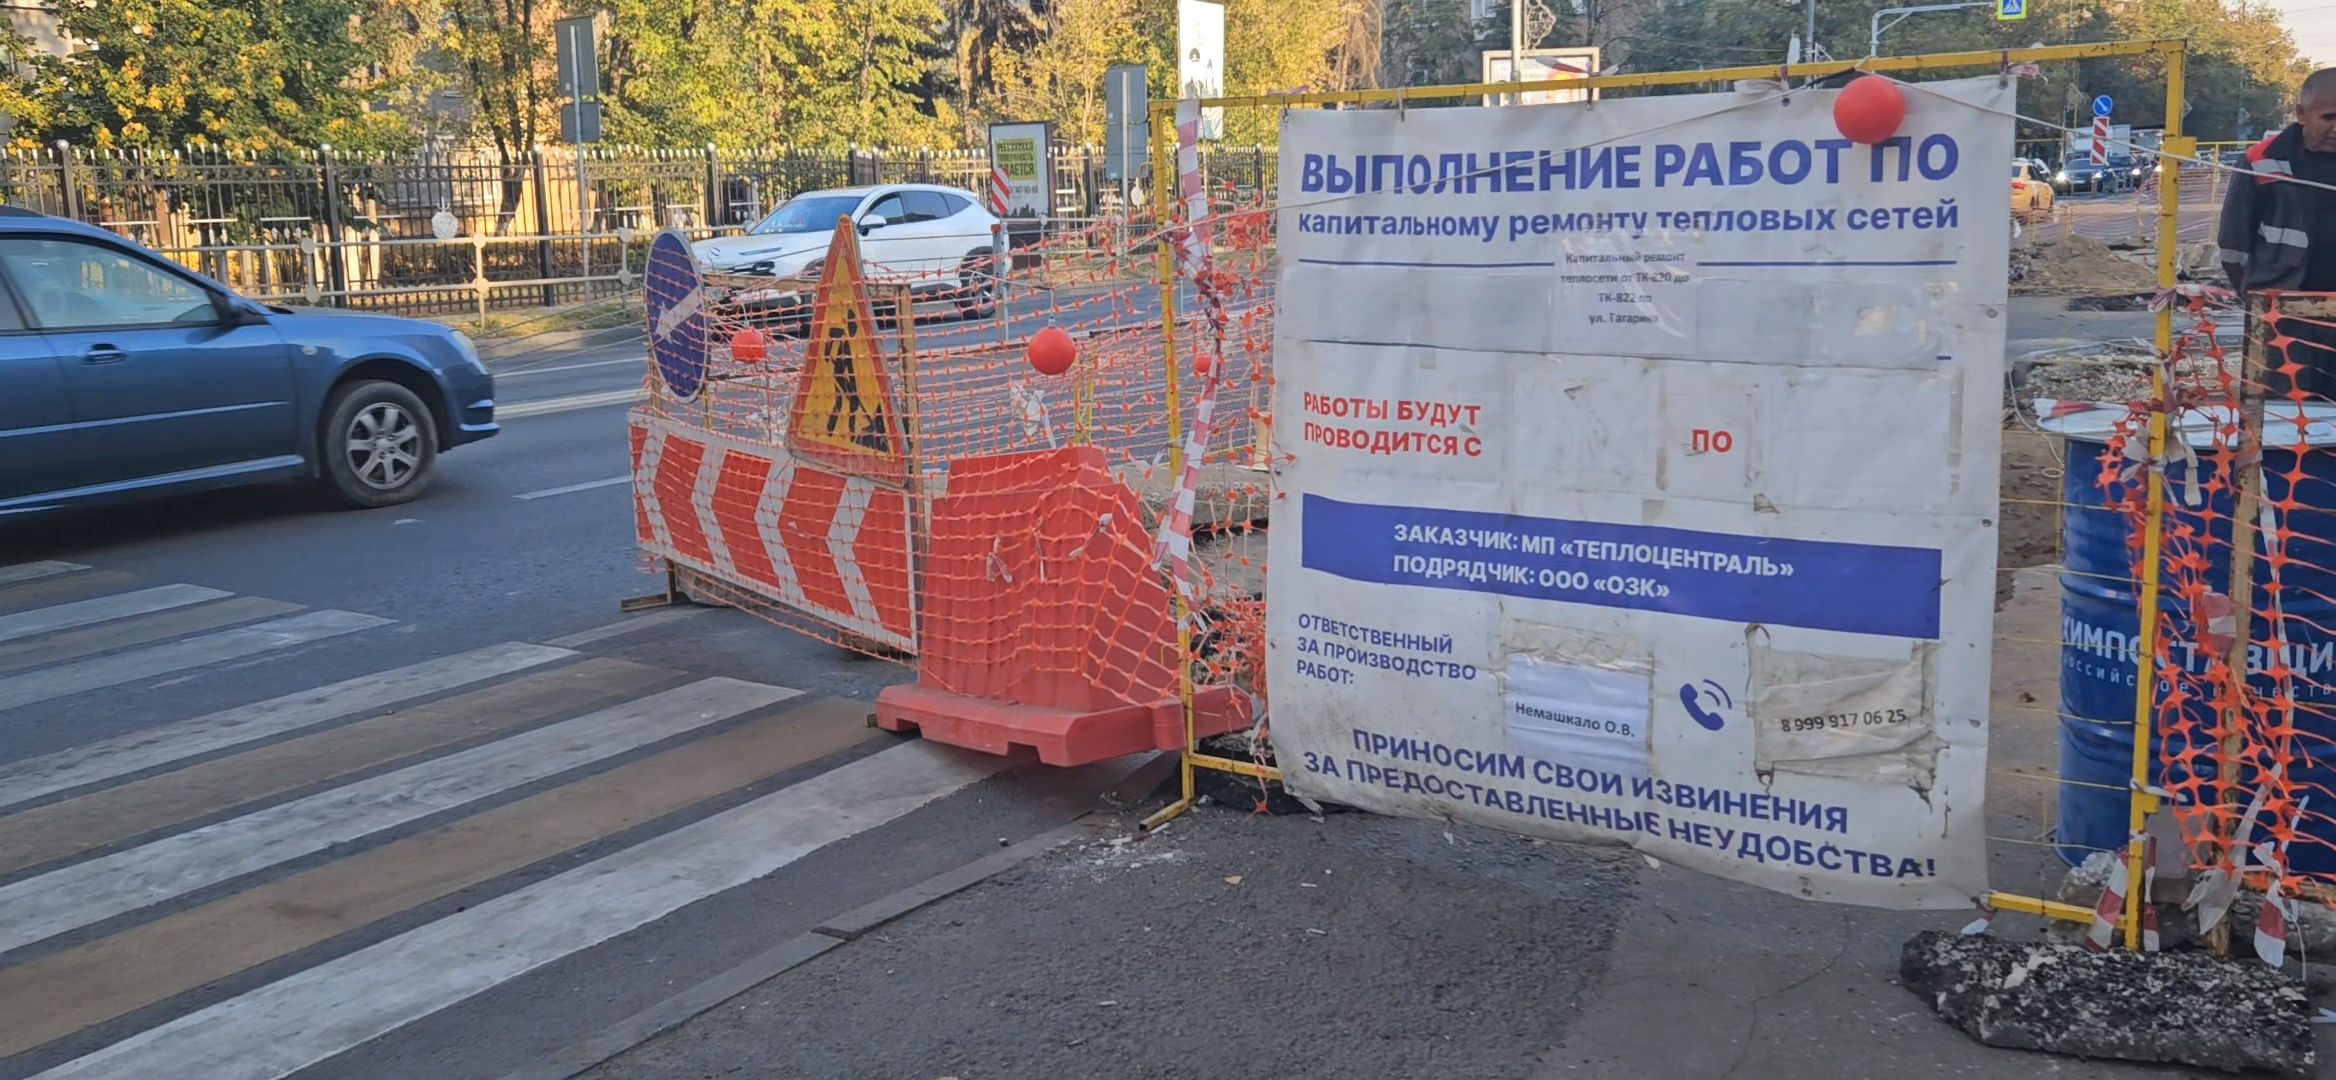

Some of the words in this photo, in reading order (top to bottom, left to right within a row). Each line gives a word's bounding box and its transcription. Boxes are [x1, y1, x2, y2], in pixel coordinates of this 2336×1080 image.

[1301, 145, 1642, 194] ВЫПОЛНЕНИЕ
[1654, 139, 1853, 187] РАБОТ
[1870, 133, 1959, 183] ПО
[1299, 213, 1500, 242] капитальному
[1509, 211, 1647, 242] ремонту
[1656, 208, 1837, 232] тепловых
[1847, 198, 1959, 230] сетей
[1566, 251, 1641, 263] Капитальный
[1643, 253, 1685, 263] ремонт
[1560, 275, 1618, 283] теплосети
[1674, 275, 1690, 284] до
[1598, 293, 1636, 303] ТК-822
[1589, 315, 1606, 325] ул.
[1304, 391, 1388, 420] РАБОТЫ
[1397, 400, 1481, 428] БУДУТ
[1305, 422, 1458, 456] ПРОВОДИТСЯ
[1464, 436, 1482, 457] С
[1691, 429, 1732, 453] ПО
[1394, 524, 1518, 550] ЗАКАЗЧИК:
[1522, 535, 1555, 555] МП
[1560, 539, 1794, 577] «ТЕПЛОЦЕНТРАЛЬ»
[1394, 555, 1535, 585] ПОДРЯДЧИК:
[1539, 569, 1589, 590] ООО
[1593, 575, 1670, 597] «ОЗК»
[1298, 613, 1453, 654] ОТВЕТСТВЕННЫЙ
[1296, 659, 1354, 684] РАБОТ:
[1297, 637, 1319, 655] ЗА
[1323, 642, 1476, 680] ПРОИЗВОДСТВО
[1515, 702, 1601, 730] Немашкало
[1604, 720, 1635, 738] О.В.
[1781, 719, 1791, 732] 8
[1794, 716, 1825, 731] 999
[1828, 713, 1858, 728] 917
[1863, 710, 1883, 725] 06
[1886, 708, 1907, 724] 25
[1353, 728, 1526, 780] ПРИНОСИМ
[1533, 760, 1624, 797] СВОИ
[1632, 778, 1848, 834] ИЗВИНЕНИЯ
[1303, 751, 1341, 778] ЗА
[1346, 759, 1662, 836] ПРЕДОСТАВЛЕННЫЕ
[1668, 818, 1936, 878] НЕУДОБСТВА!
